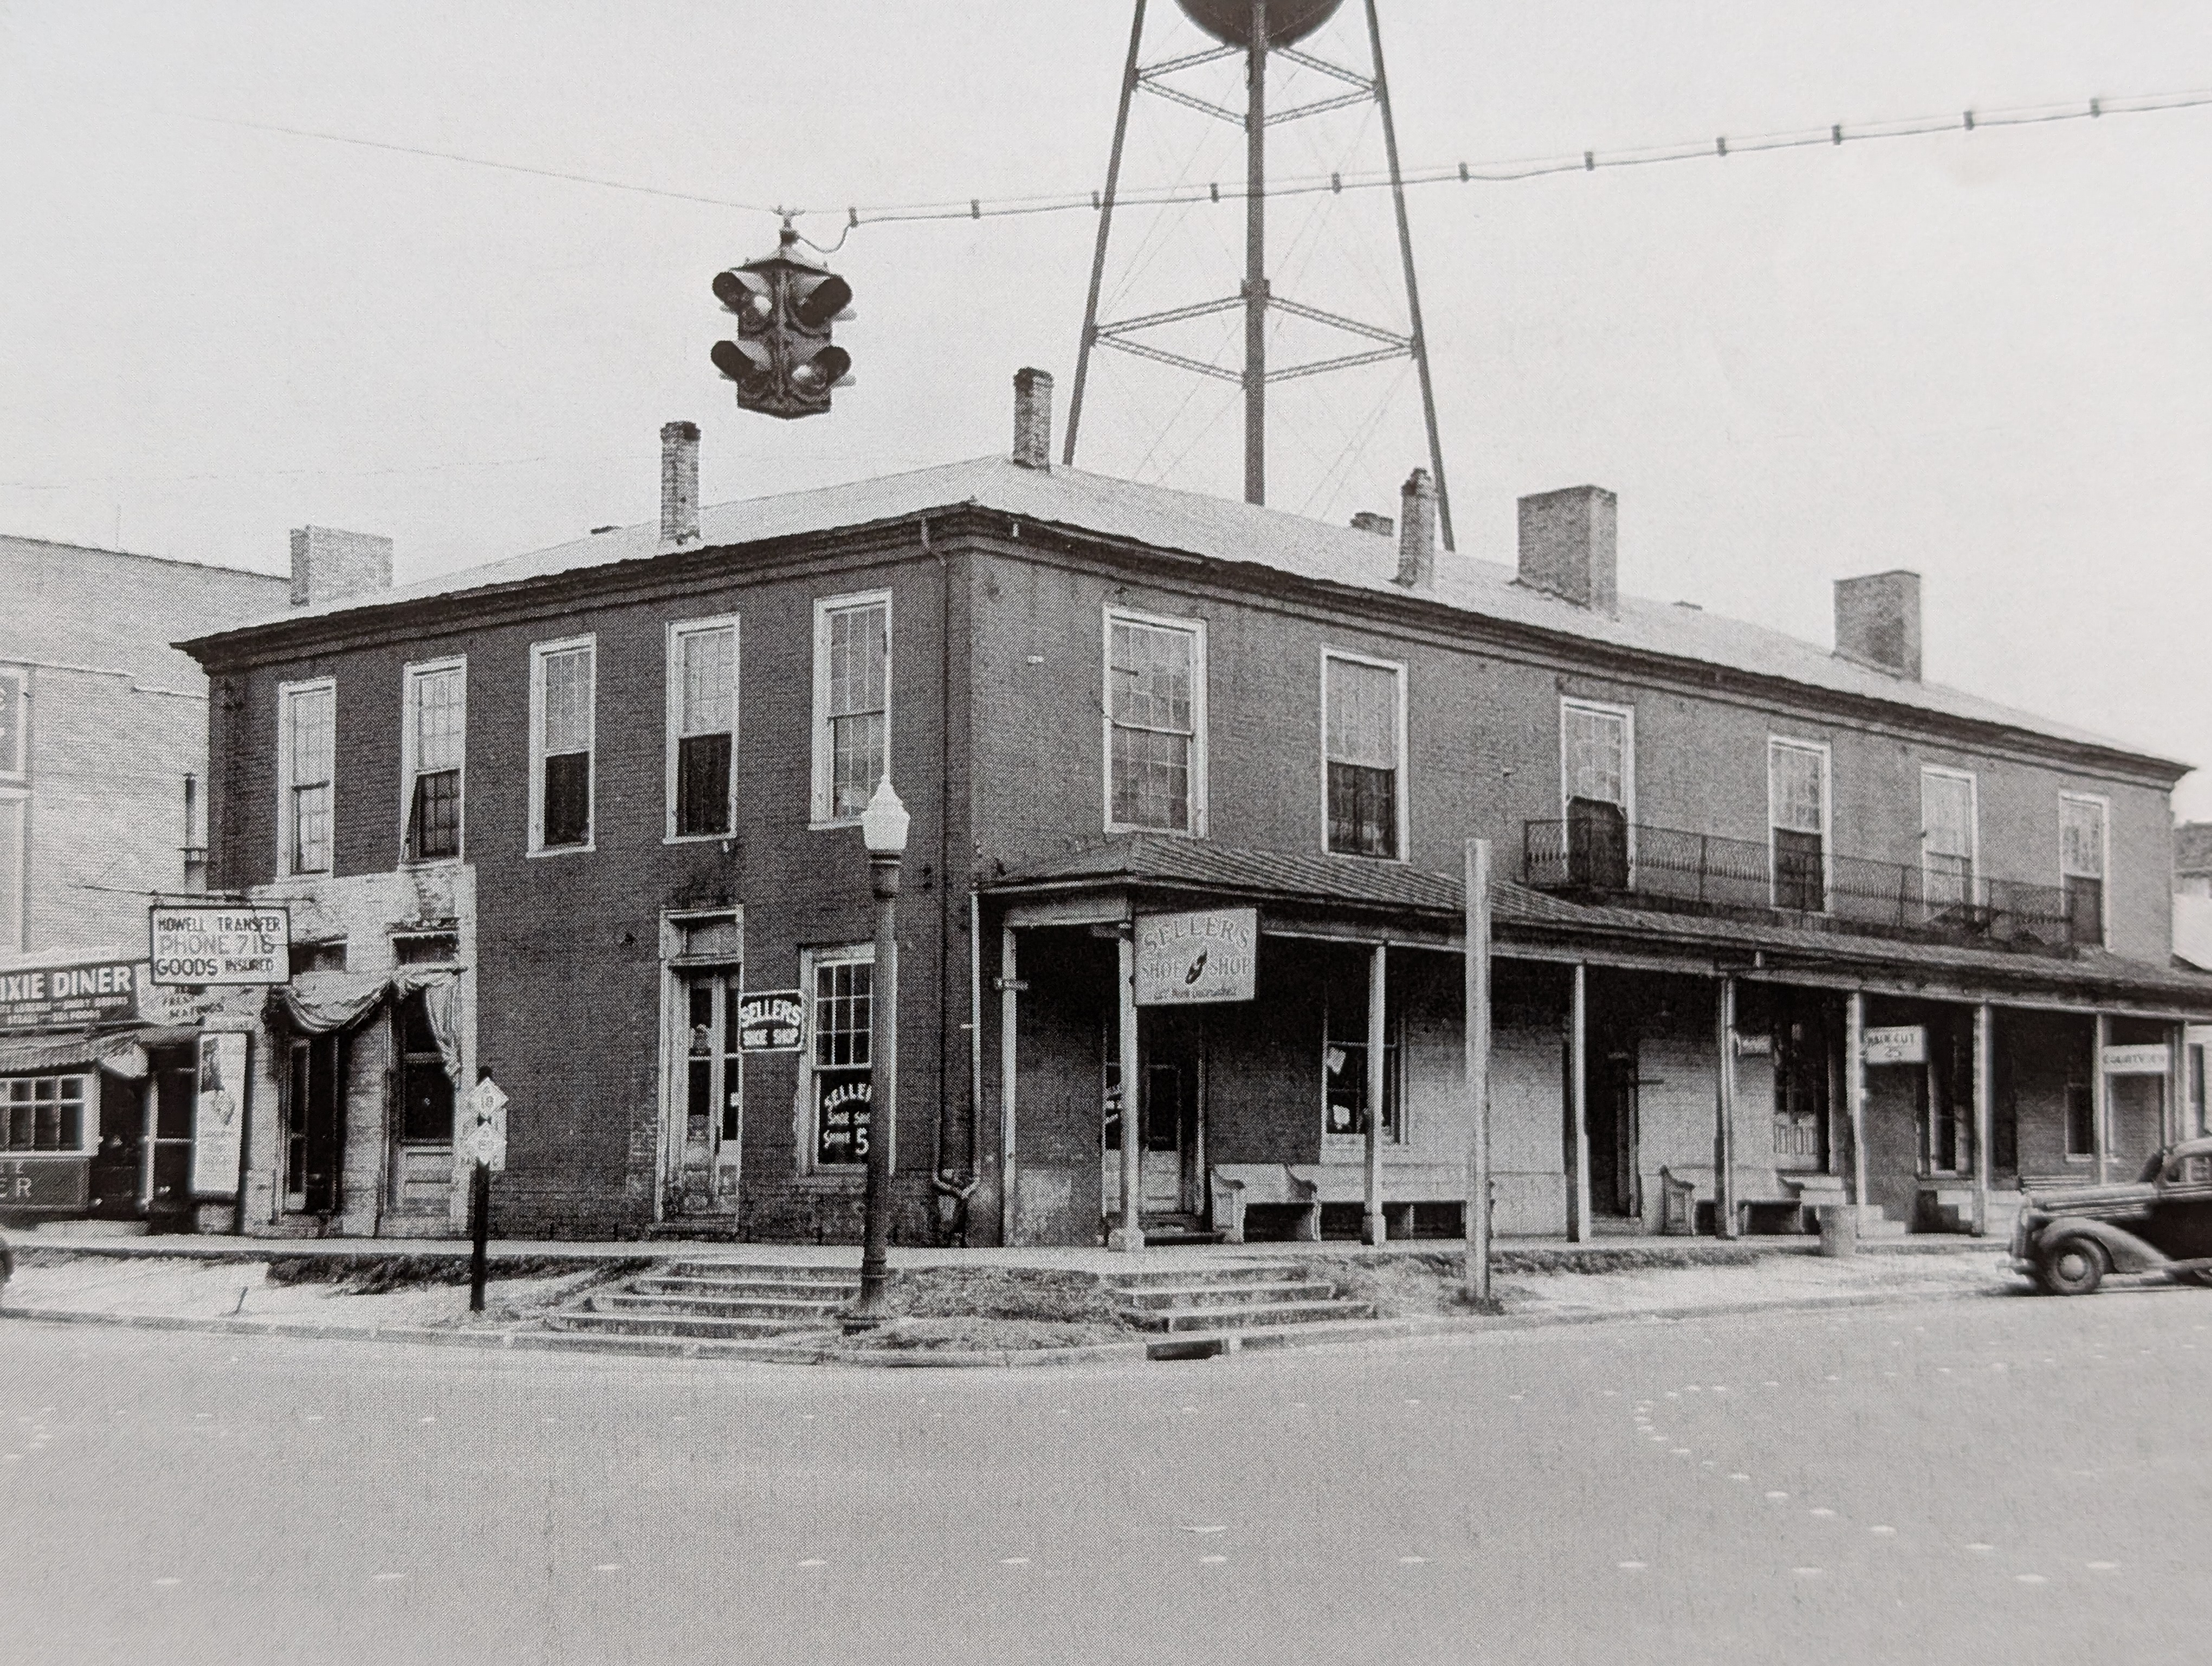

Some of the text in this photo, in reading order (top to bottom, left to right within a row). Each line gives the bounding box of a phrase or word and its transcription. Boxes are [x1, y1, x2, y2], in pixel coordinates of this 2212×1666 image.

[158, 916, 280, 932] HOWELL TRANSFER
[1144, 917, 1249, 949] SELLERS
[160, 934, 229, 954] PHONE
[156, 958, 218, 976] GOODS
[1142, 962, 1182, 978] SHOE
[1210, 958, 1250, 976] SHOP
[53, 966, 132, 998] DINER
[741, 999, 802, 1027] SELLERS
[743, 1028, 799, 1046] SHOE SHOP
